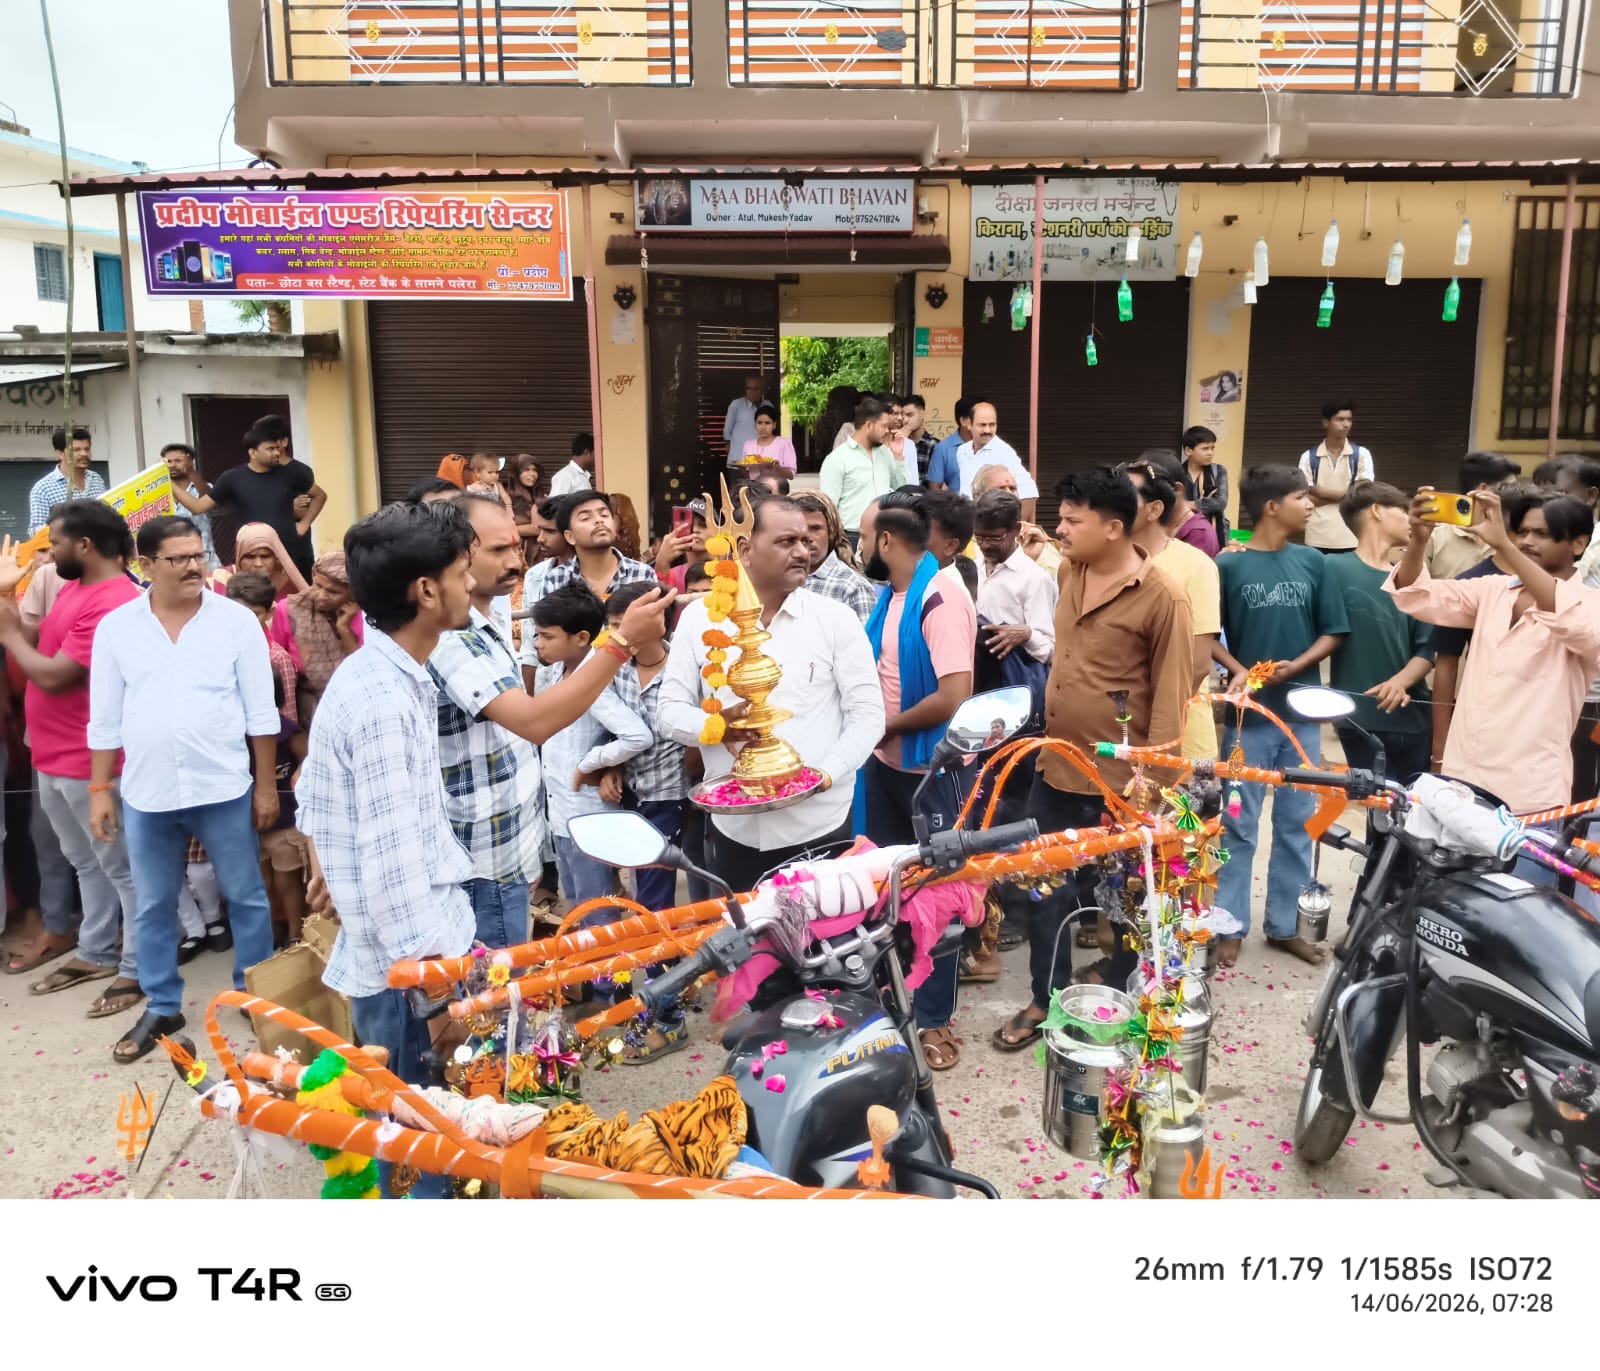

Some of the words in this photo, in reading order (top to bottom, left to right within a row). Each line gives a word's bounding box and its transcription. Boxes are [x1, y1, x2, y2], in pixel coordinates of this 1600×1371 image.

[700, 186, 740, 204] MAA
[744, 185, 833, 206] BHAGWATI
[840, 187, 908, 205] BHAVAN
[1042, 197, 1099, 212] जनरल
[153, 196, 221, 228] प्रदीप
[223, 196, 322, 229] मोबाईल
[325, 201, 380, 228] एण्ड
[382, 197, 486, 228] रिपेयरिंग
[487, 196, 553, 229] सेन्टर
[738, 213, 756, 222] Atul,
[758, 213, 788, 222] Mukesh
[789, 214, 813, 222] Yadav
[855, 214, 900, 224] 9752471824
[976, 217, 1028, 240] किराना,
[1085, 217, 1109, 238] एवं
[219, 233, 238, 243] हमारे
[256, 233, 272, 243] सभी
[275, 233, 303, 243] कंपनियों
[319, 233, 346, 243] मोबाईल
[287, 258, 302, 268] सभी
[306, 258, 334, 268] कंपनियों
[522, 264, 549, 278] प्रदीप
[245, 278, 274, 288] पता-
[278, 276, 302, 288] छोटा
[305, 279, 323, 288] बस
[358, 276, 376, 288] स्टेट
[379, 274, 397, 288] बैंक
[401, 276, 411, 288] के
[414, 276, 444, 289] सामने
[448, 277, 477, 289] पलेरा
[920, 377, 940, 389] लाभ
[1419, 915, 1463, 943] HERO
[1415, 923, 1469, 957] HONDA
[826, 1033, 898, 1074] PLATINA
